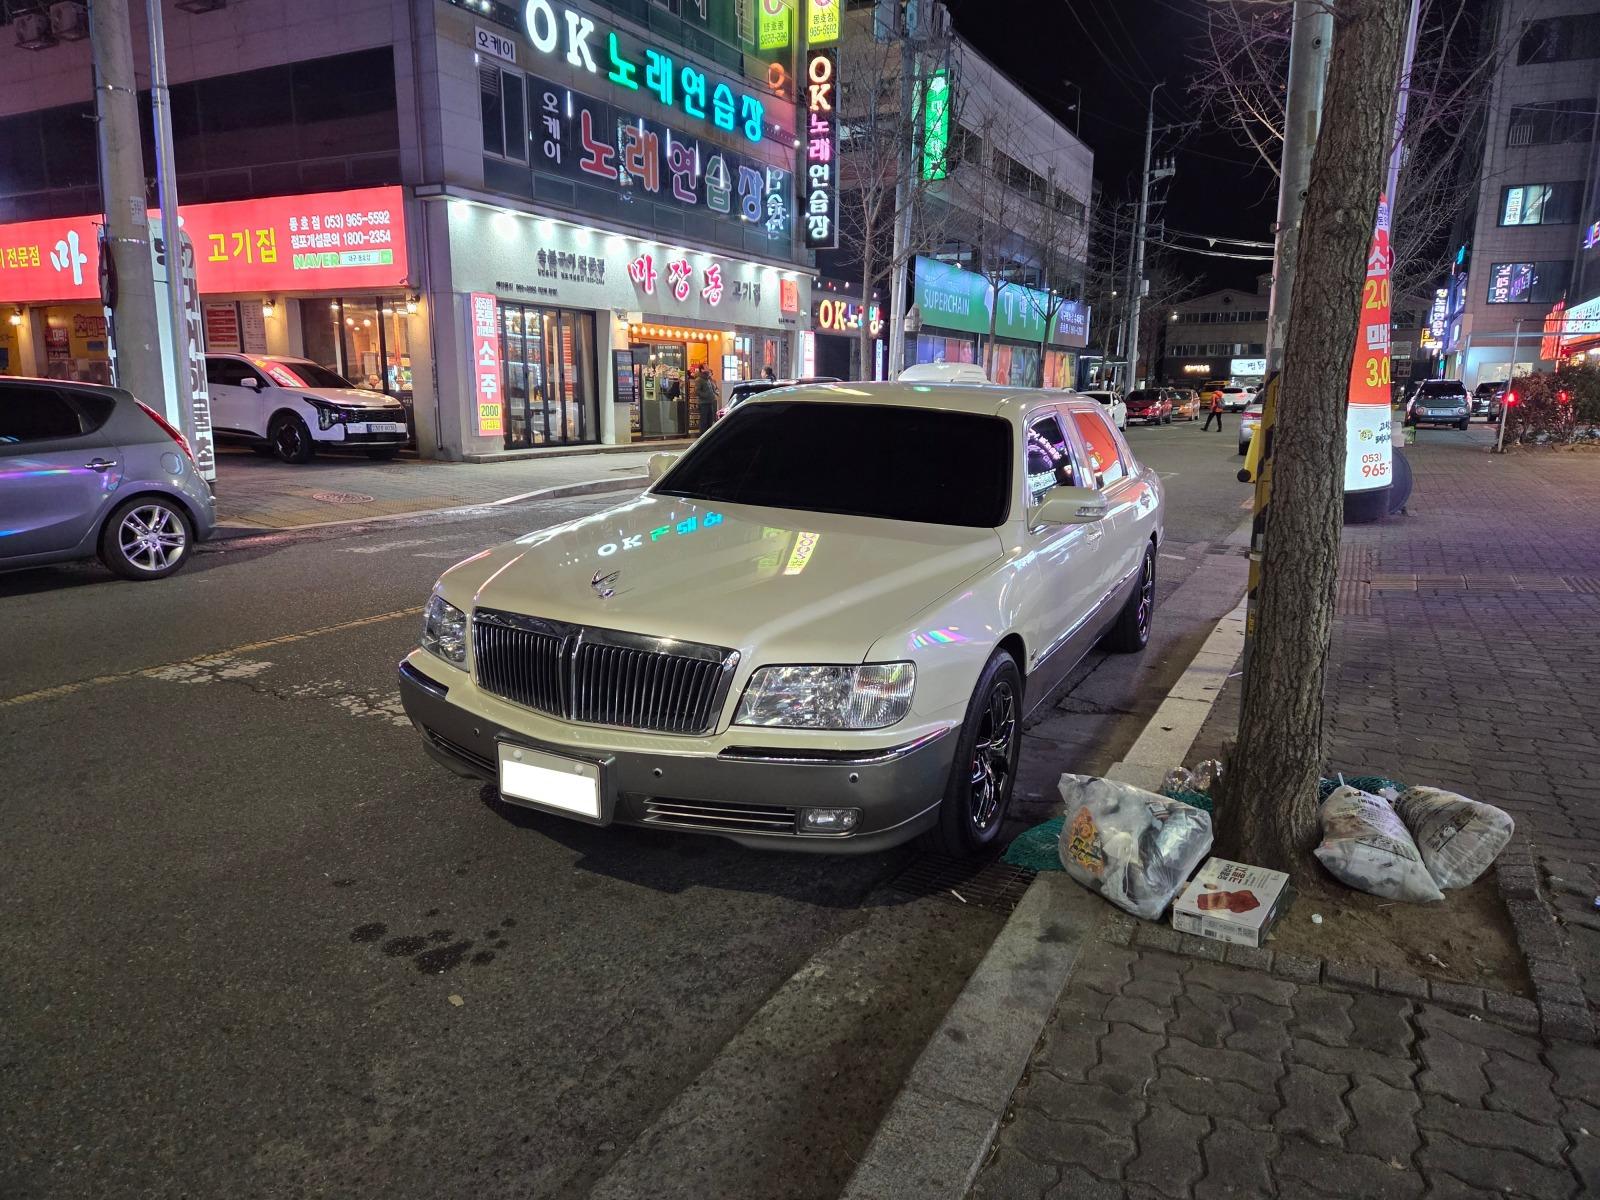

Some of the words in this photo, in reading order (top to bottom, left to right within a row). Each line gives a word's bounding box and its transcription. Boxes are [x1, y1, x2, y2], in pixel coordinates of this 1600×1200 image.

[478, 31, 514, 60] 오케이
[542, 92, 561, 164] 오케이
[579, 109, 764, 222] 노래연습장
[324, 213, 344, 229] 053)
[345, 210, 390, 227] 965-5592
[207, 227, 277, 264] 고기집
[343, 229, 391, 246] 1800-2354
[6, 245, 41, 269] 전문점
[293, 252, 340, 270] NAVER
[1366, 246, 1389, 277] 소
[924, 289, 969, 316] SUPERCHAIN
[479, 341, 497, 399] 소주
[481, 405, 499, 417] 2000
[1362, 452, 1382, 463] 053)
[1362, 460, 1391, 478] 965-
